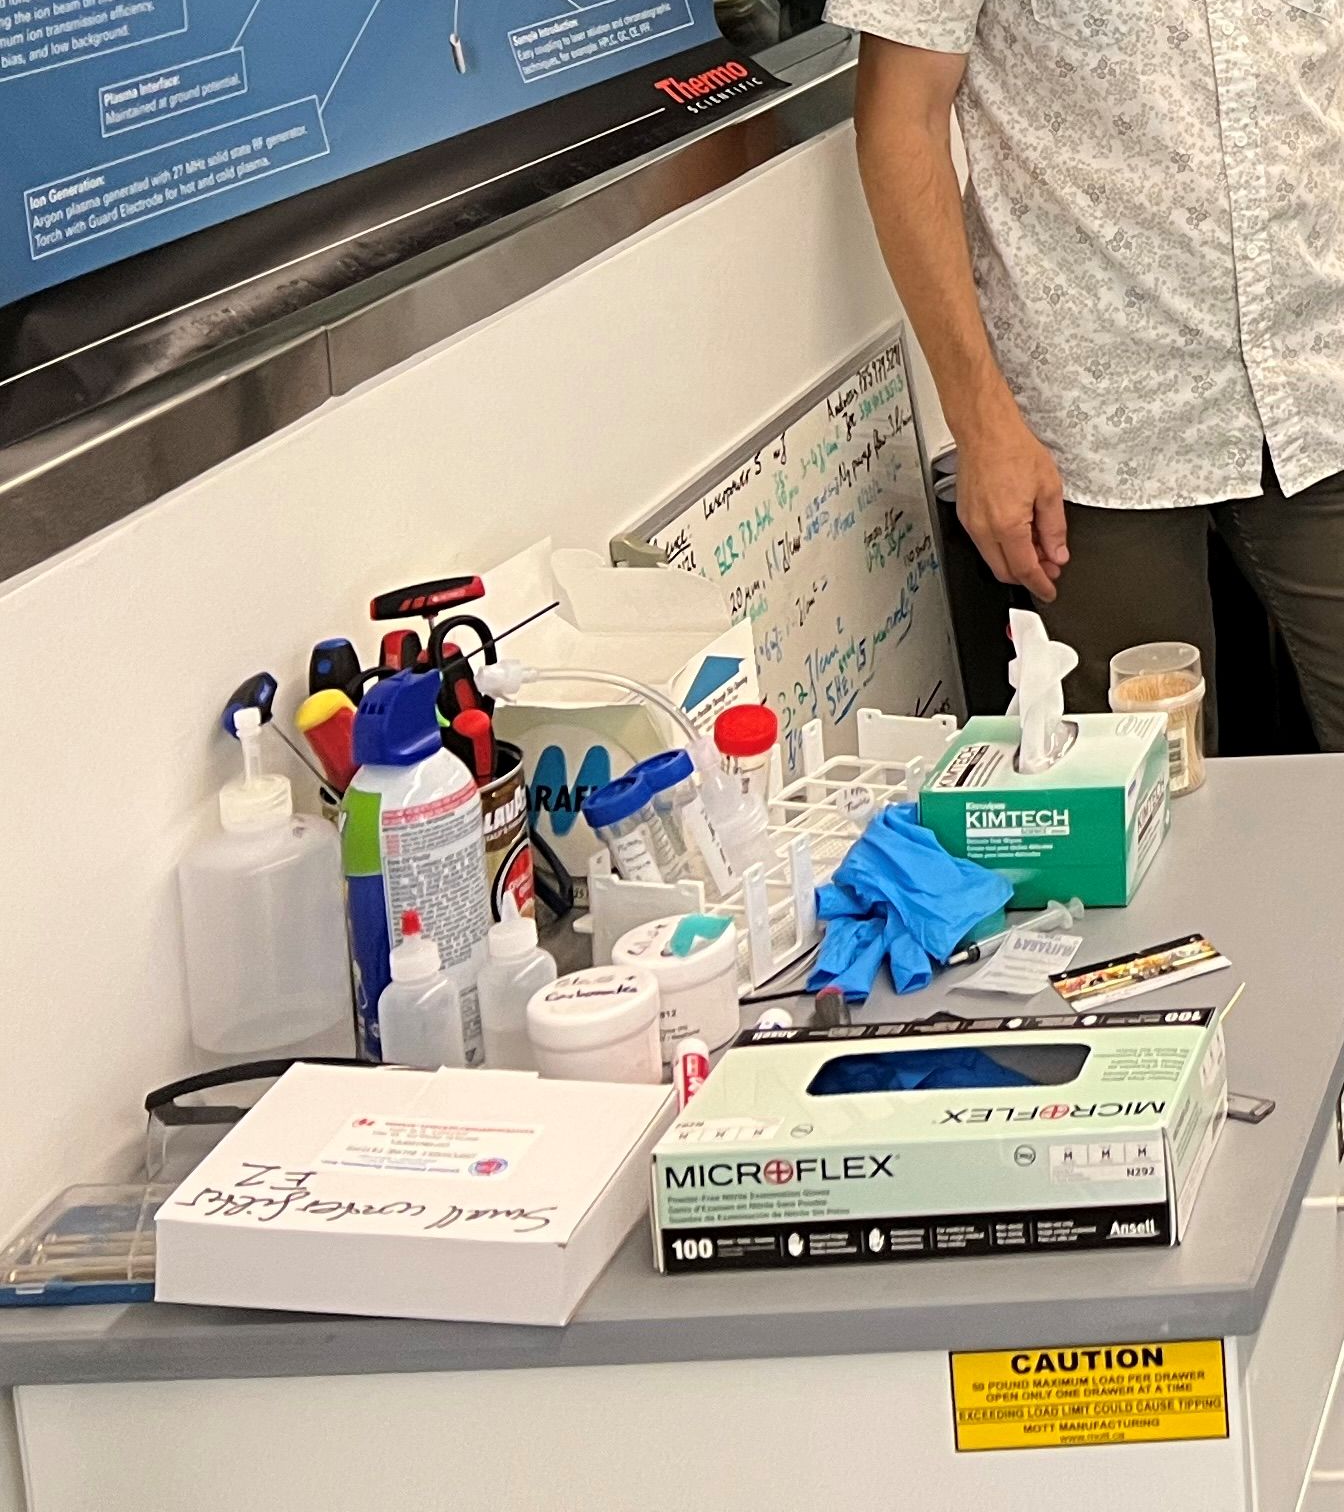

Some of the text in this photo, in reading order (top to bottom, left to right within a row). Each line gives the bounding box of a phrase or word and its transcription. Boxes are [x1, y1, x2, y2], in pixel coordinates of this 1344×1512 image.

[13, 7, 31, 25] the
[33, 5, 50, 20] ion
[26, 26, 43, 42] ion
[45, 12, 108, 37] transmission
[2, 25, 130, 68] bias, and low background.
[655, 60, 749, 103] Thermo
[104, 88, 138, 106] Plasma
[687, 76, 763, 114] SCIENTIFIC
[29, 174, 105, 209] Ion Generation:
[32, 210, 63, 229] Argon
[65, 196, 101, 220] plasma
[103, 177, 149, 206] generated
[150, 168, 171, 187] with
[172, 165, 184, 179] 27
[34, 228, 63, 247] Torch
[65, 220, 87, 237] with
[89, 209, 118, 230] Guard
[120, 193, 163, 218] Electrode
[165, 188, 178, 201] for
[180, 182, 196, 197] hot
[197, 176, 215, 192] and
[939, 746, 975, 788] KIMTECH
[966, 809, 1069, 828] KIMTECH
[1165, 1010, 1202, 1023] 100
[752, 1029, 798, 1042] Ansell
[942, 1101, 1166, 1124] MICROFLEX
[1064, 1148, 1147, 1161] M M M
[665, 1154, 893, 1188] MICROFLEX
[1126, 1167, 1155, 1177] N292
[1111, 1219, 1155, 1236] Ansell
[672, 1238, 713, 1260] 100
[1011, 1347, 1164, 1374] CAUTION
[988, 1379, 1029, 1392] POUND
[1032, 1376, 1088, 1389] MAXIMUM
[1092, 1374, 1124, 1386] LOAD
[1127, 1373, 1151, 1384] PER
[1155, 1370, 1205, 1382] DRAWER
[986, 1382, 1193, 1403] OPEN ONLY ONE DRAWER AT A TIME
[958, 1397, 1222, 1422] EXCEEDING LOAD LIMIT COULD CAUSE TIPPING
[1023, 1418, 1160, 1434] MOTT MANUFACTURING
